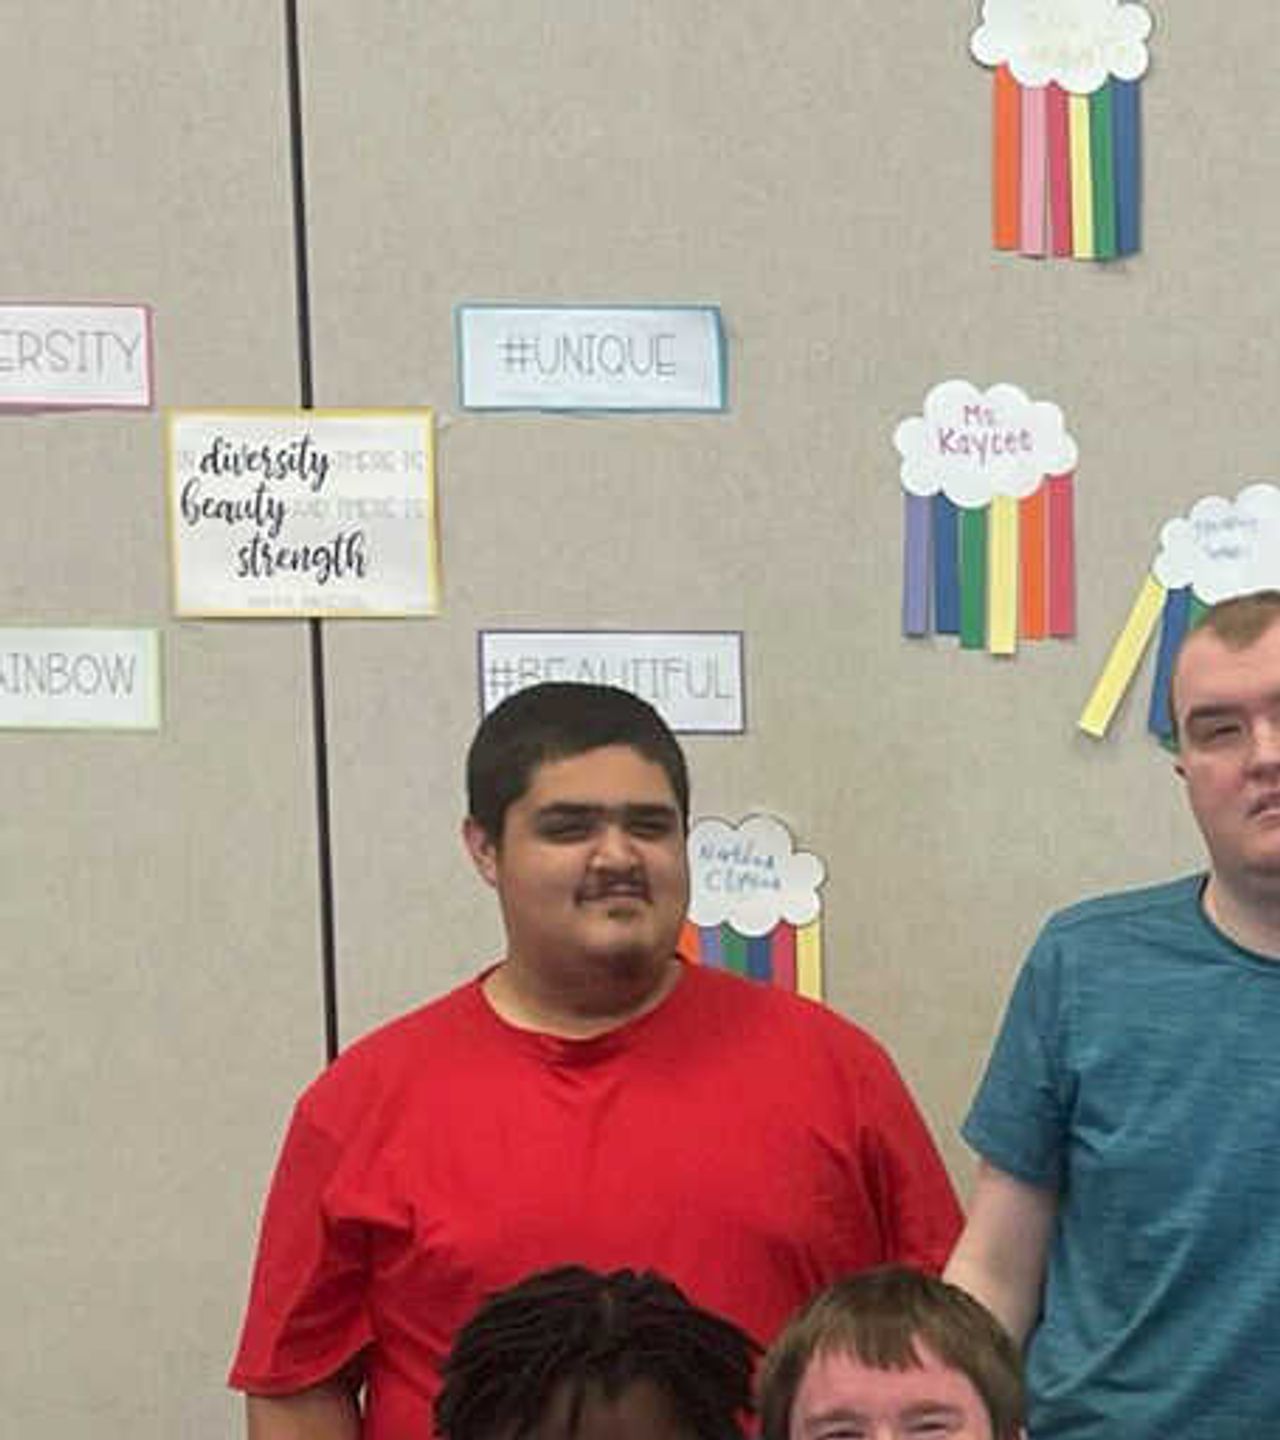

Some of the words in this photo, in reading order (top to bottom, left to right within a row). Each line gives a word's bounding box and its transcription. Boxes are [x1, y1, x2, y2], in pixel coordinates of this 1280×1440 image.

[499, 334, 677, 376] #UNIQUE
[200, 436, 329, 492] diversity
[181, 476, 285, 538] beauty
[237, 532, 365, 586] strength
